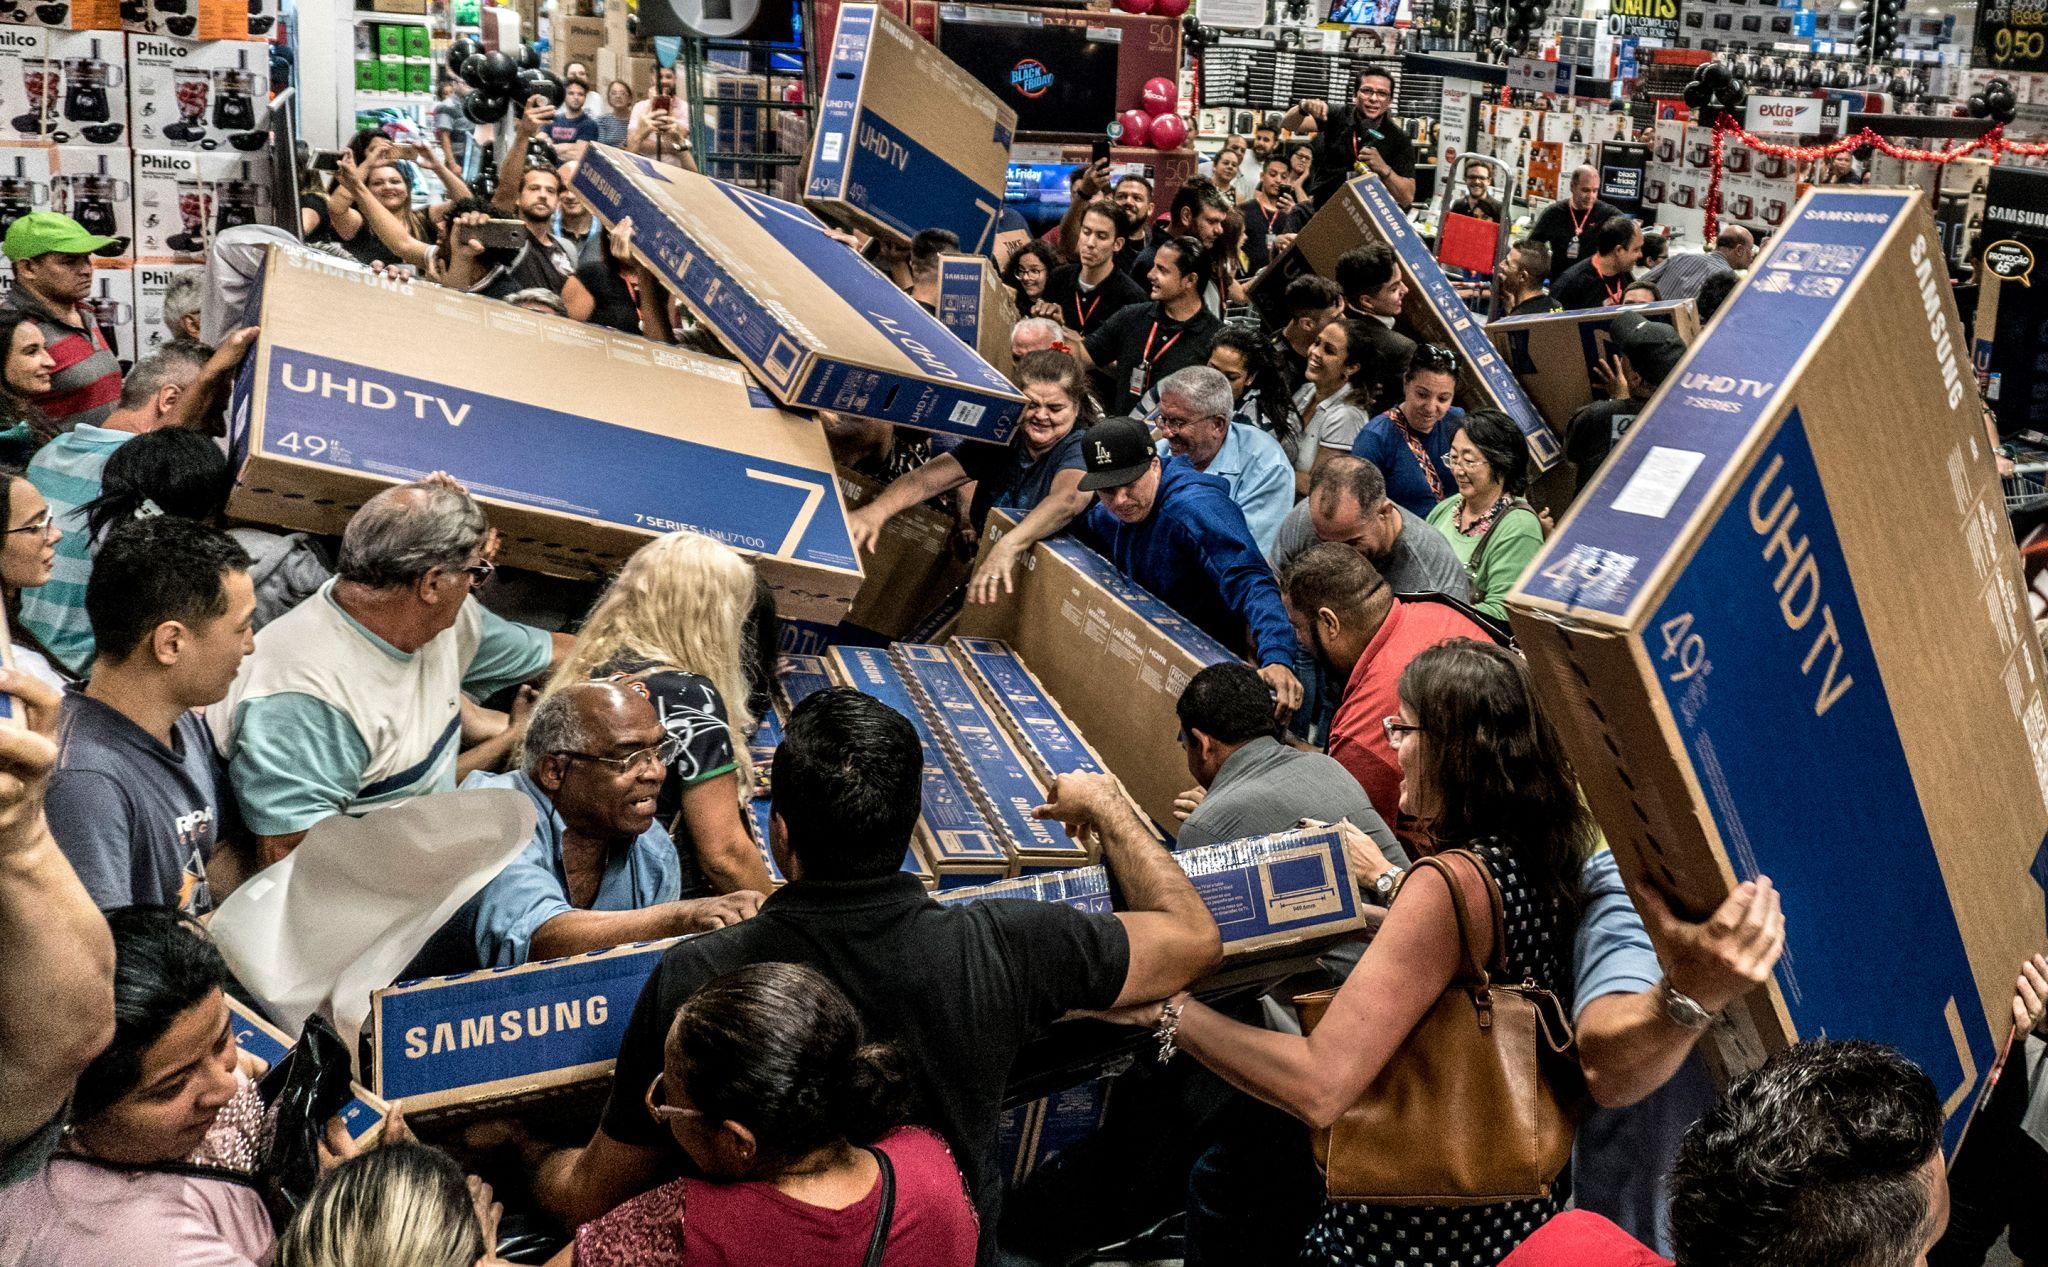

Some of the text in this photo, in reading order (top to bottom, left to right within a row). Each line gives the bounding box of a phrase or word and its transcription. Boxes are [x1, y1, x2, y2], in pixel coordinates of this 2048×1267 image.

[1639, 16, 1679, 30] COMPLETO
[1149, 24, 1174, 45] 50
[137, 41, 188, 58] Philco
[1011, 66, 1041, 85] BLACK
[1023, 73, 1054, 91] FRIDAY
[826, 100, 854, 109] UHD TV
[1759, 103, 1793, 117] extra
[859, 122, 909, 171] UHD TV
[141, 154, 192, 170] Philco
[1164, 159, 1190, 180] 50
[581, 162, 622, 207] SAMSUNG
[1016, 168, 1042, 182] Friday
[1618, 170, 1637, 178] black
[1605, 185, 1636, 196] Samsung
[1364, 183, 1406, 238] SAMSUNG
[1803, 209, 1890, 225] SAMSUNG
[1988, 205, 2048, 229] SAMSUN
[1988, 251, 2029, 265] PROMOÇÃO
[142, 271, 172, 285] Phi
[289, 254, 416, 297] SAMSUNG
[944, 273, 979, 282] SAMSUNG
[1910, 234, 1964, 411] SAMSUNG
[868, 310, 958, 379] UHD TV
[282, 363, 472, 427] UHD TV
[1680, 372, 1774, 398] UHD TV
[910, 386, 935, 423] UHD TV
[1094, 440, 1113, 465] LA
[633, 513, 642, 524] 7
[646, 516, 698, 533] SERIES
[745, 467, 826, 560] 7
[1749, 453, 1855, 718] UHD TV
[1149, 647, 1167, 666] HDMI
[855, 650, 886, 685] SAMSUNG
[404, 993, 609, 1060] SAMSUNG
[1943, 995, 1979, 1123] 7
